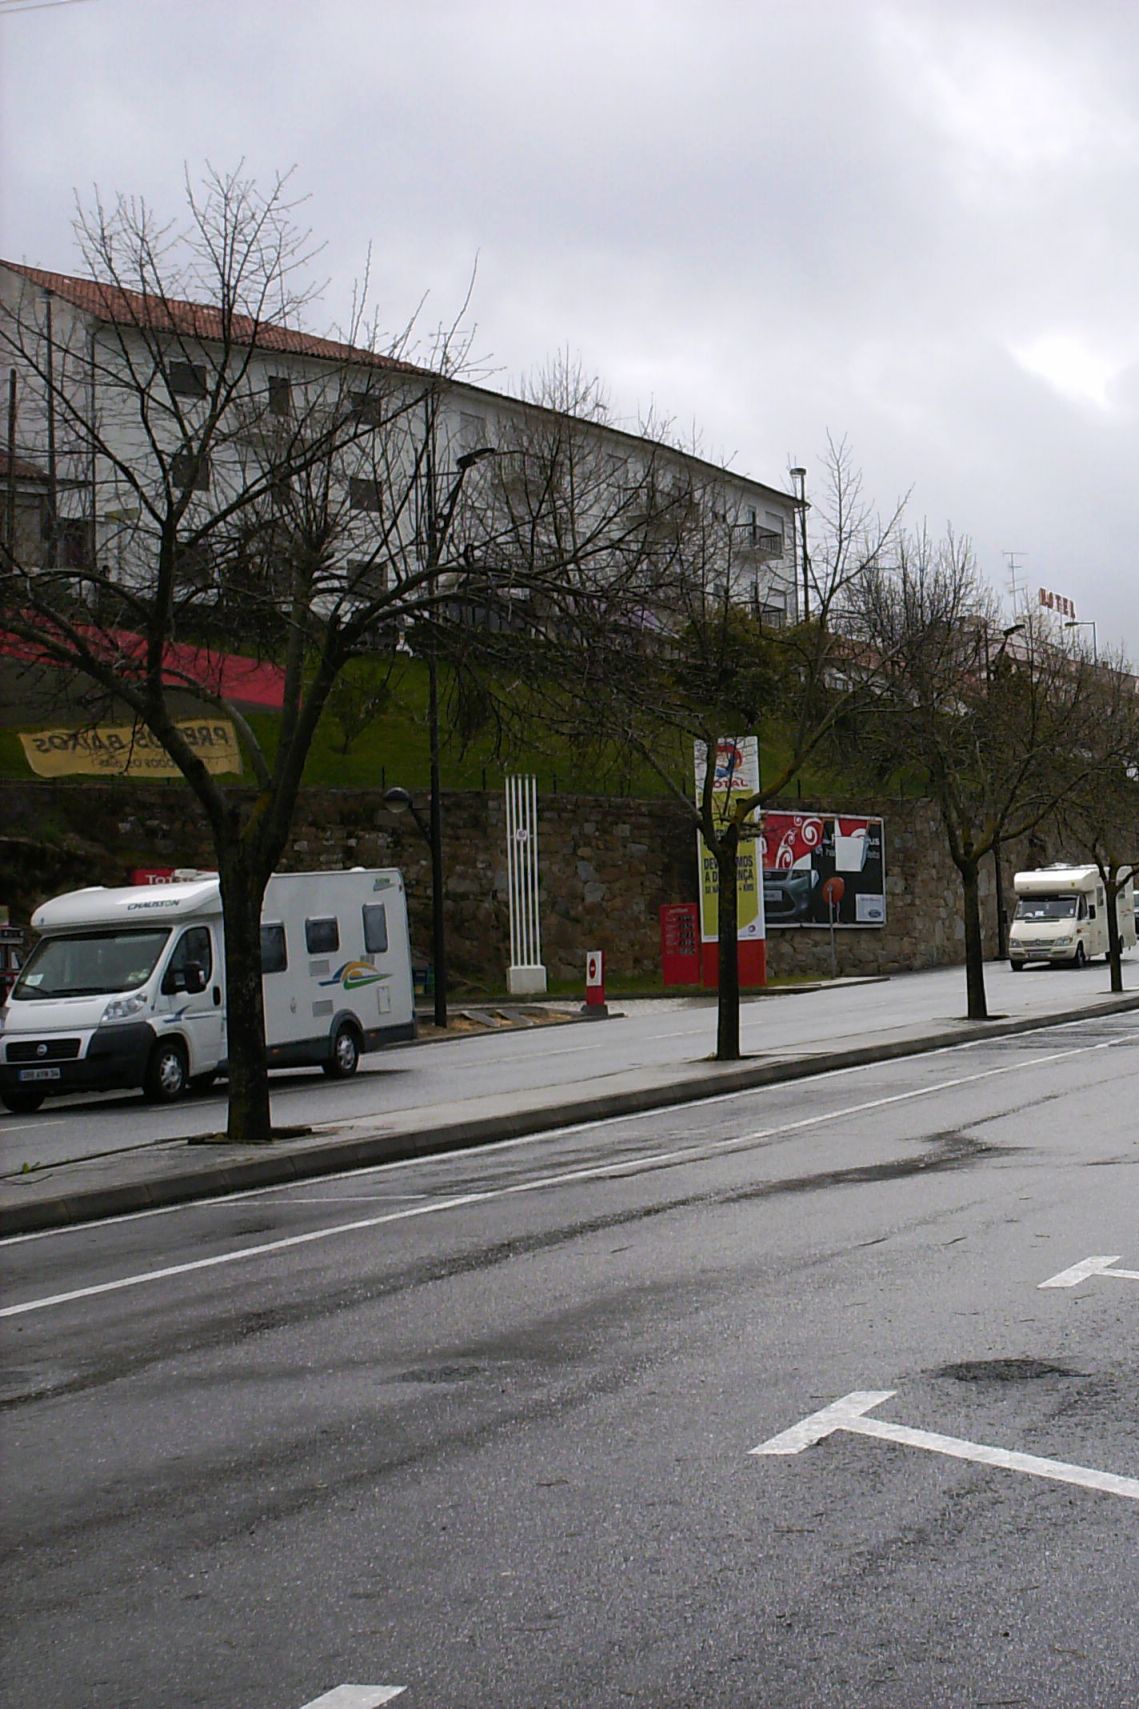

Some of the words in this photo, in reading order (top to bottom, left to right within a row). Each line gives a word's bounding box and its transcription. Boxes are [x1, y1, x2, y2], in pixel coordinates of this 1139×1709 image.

[1039, 587, 1076, 619] HOTEL
[713, 779, 749, 789] OTAL
[703, 855, 753, 870] DEVMOS
